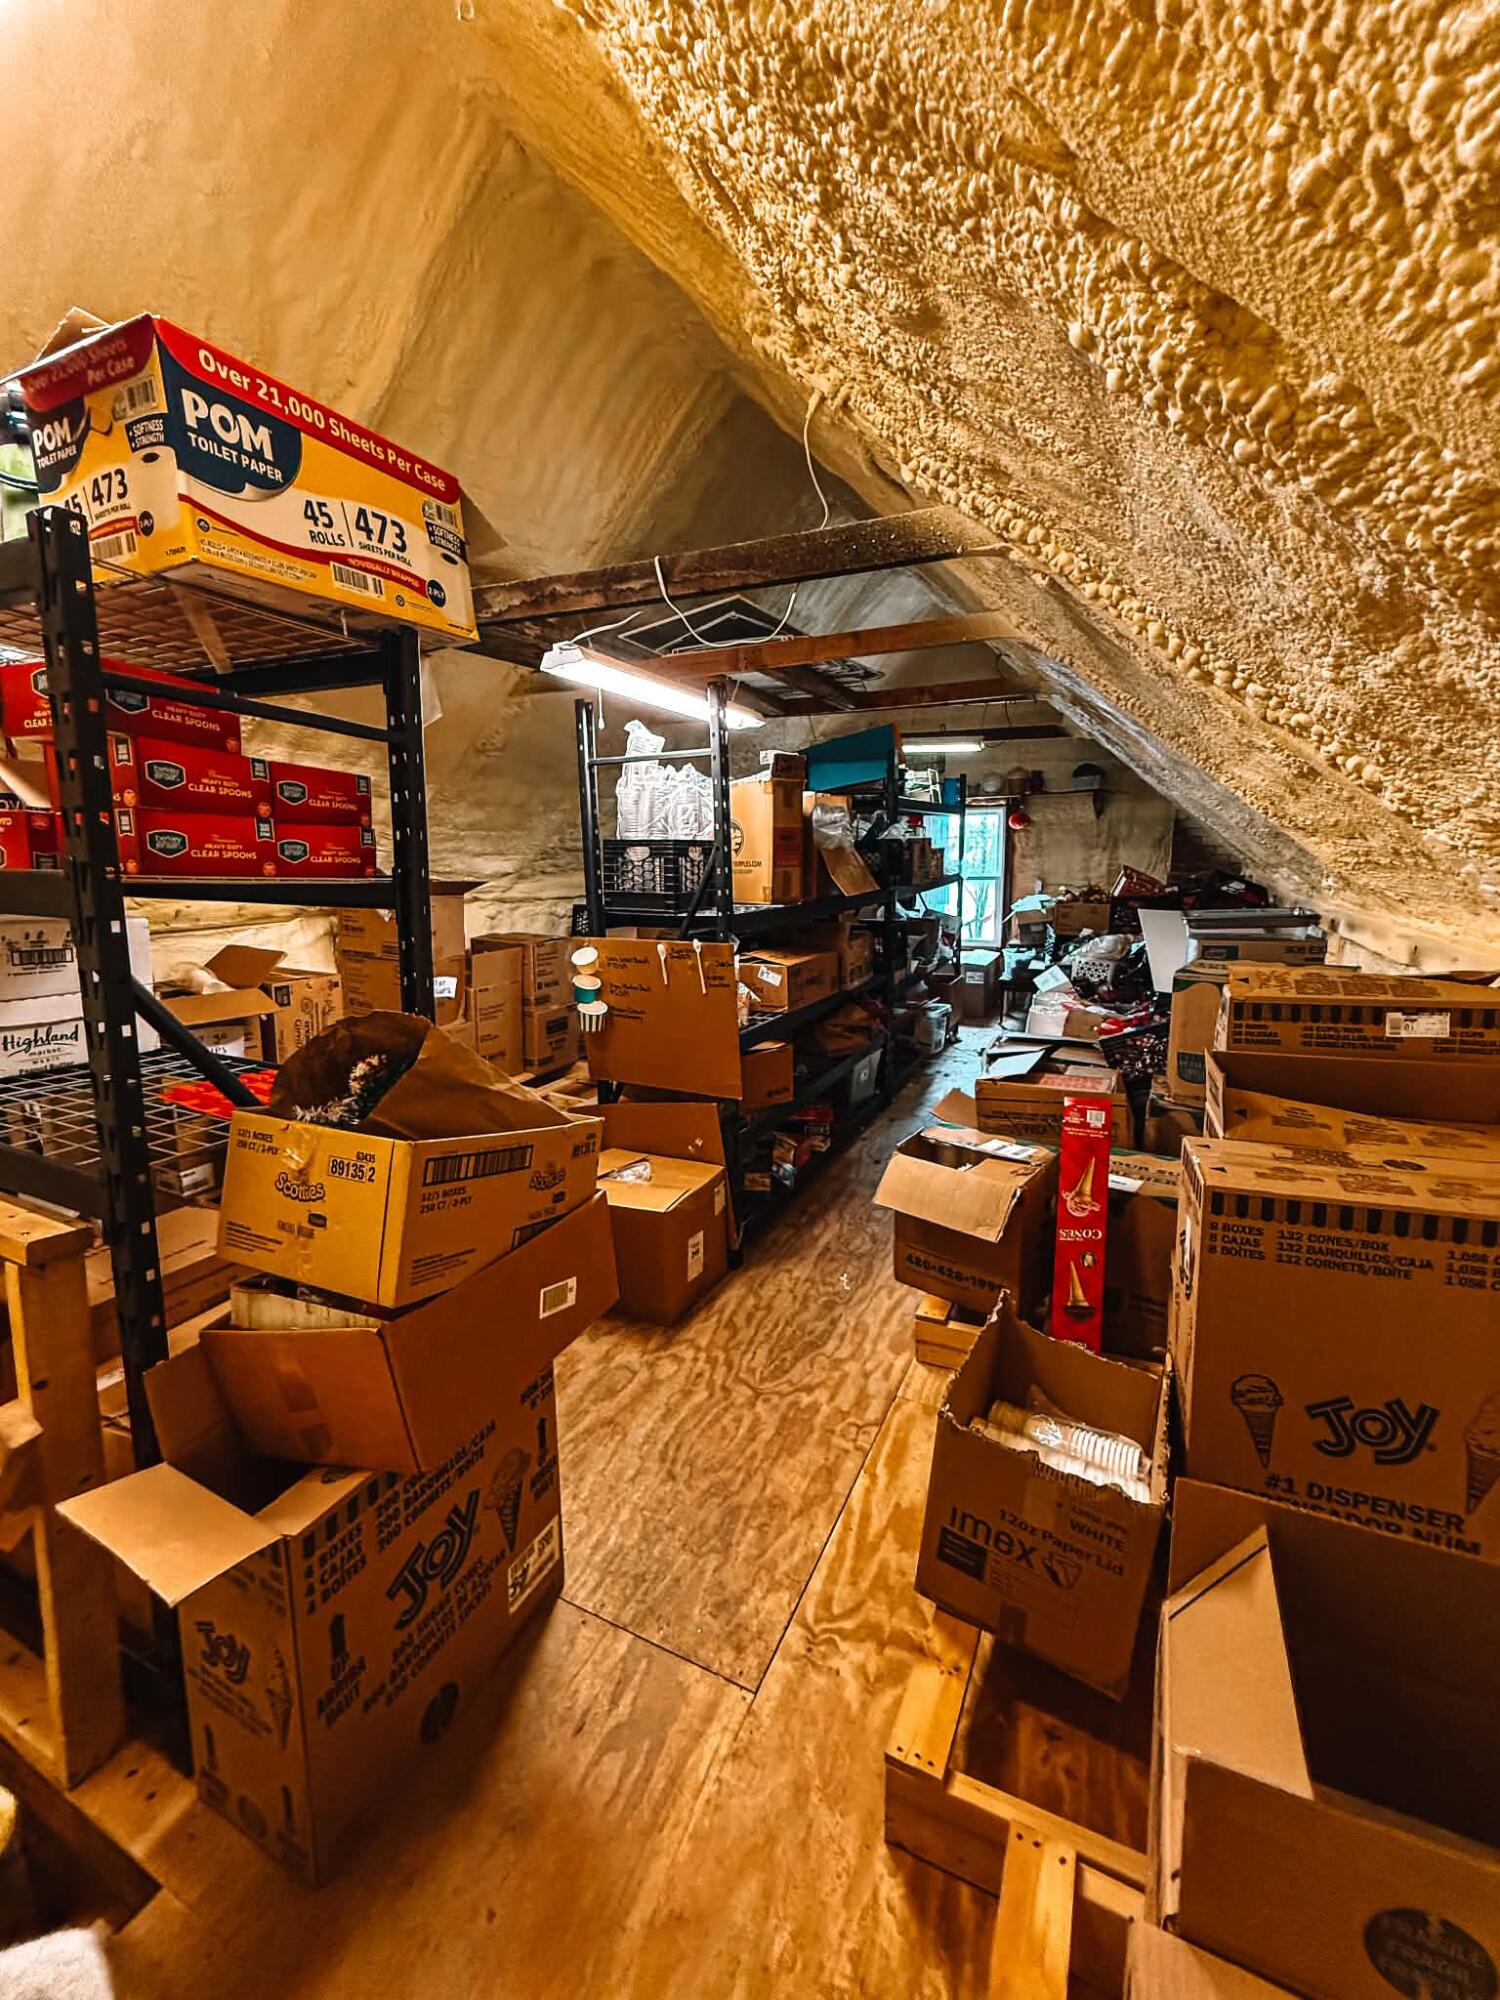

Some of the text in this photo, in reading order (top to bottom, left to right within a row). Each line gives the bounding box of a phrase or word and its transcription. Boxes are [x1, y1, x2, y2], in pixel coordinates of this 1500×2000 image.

[132, 418, 164, 438] SOFTNESS
[181, 388, 275, 462] POM
[199, 348, 447, 492] Over 21,000 Sheets Per Case
[31, 416, 72, 458] POM
[36, 444, 78, 470] TOILET PAPER
[187, 431, 285, 484] TOILET PAPER
[91, 467, 129, 508] 473
[303, 498, 335, 530] 45
[309, 529, 347, 548] ROLLS
[354, 506, 408, 554] 473
[358, 540, 385, 557] SHEETS
[383, 548, 397, 561] PER
[23, 718, 47, 729] CLEAR
[151, 709, 221, 732] CLEAR SPOONS
[188, 782, 253, 799] CLEAR SPOONS
[308, 798, 330, 808] CLEAR
[190, 849, 257, 860] CLEAR SPOONS
[310, 855, 362, 864] CLEAR SPOONS
[2, 1023, 80, 1053] Highland
[330, 1158, 377, 1183] 89135 2
[441, 1186, 468, 1200] BOXES
[436, 1200, 448, 1212] CT
[1208, 1232, 1262, 1248] 8 CAJAS
[1209, 1221, 1265, 1238] 8 BOXES
[1277, 1229, 1391, 1253] 132 CONES/BOX
[1208, 1243, 1218, 1255] 8
[1275, 1252, 1302, 1267] 132
[1276, 1241, 1434, 1270] 132 BARQUILLOS/CAJA
[1264, 1473, 1300, 1495] #1
[1307, 1481, 1467, 1535] DISPENSER
[317, 1521, 365, 1567] BOXES
[377, 1522, 402, 1552] 200
[999, 1508, 1038, 1537] 12oz
[1040, 1528, 1092, 1562] Paper
[1095, 1555, 1126, 1578] Lid
[1069, 1518, 1127, 1550] WHITE
[319, 1541, 364, 1586] CAJAS
